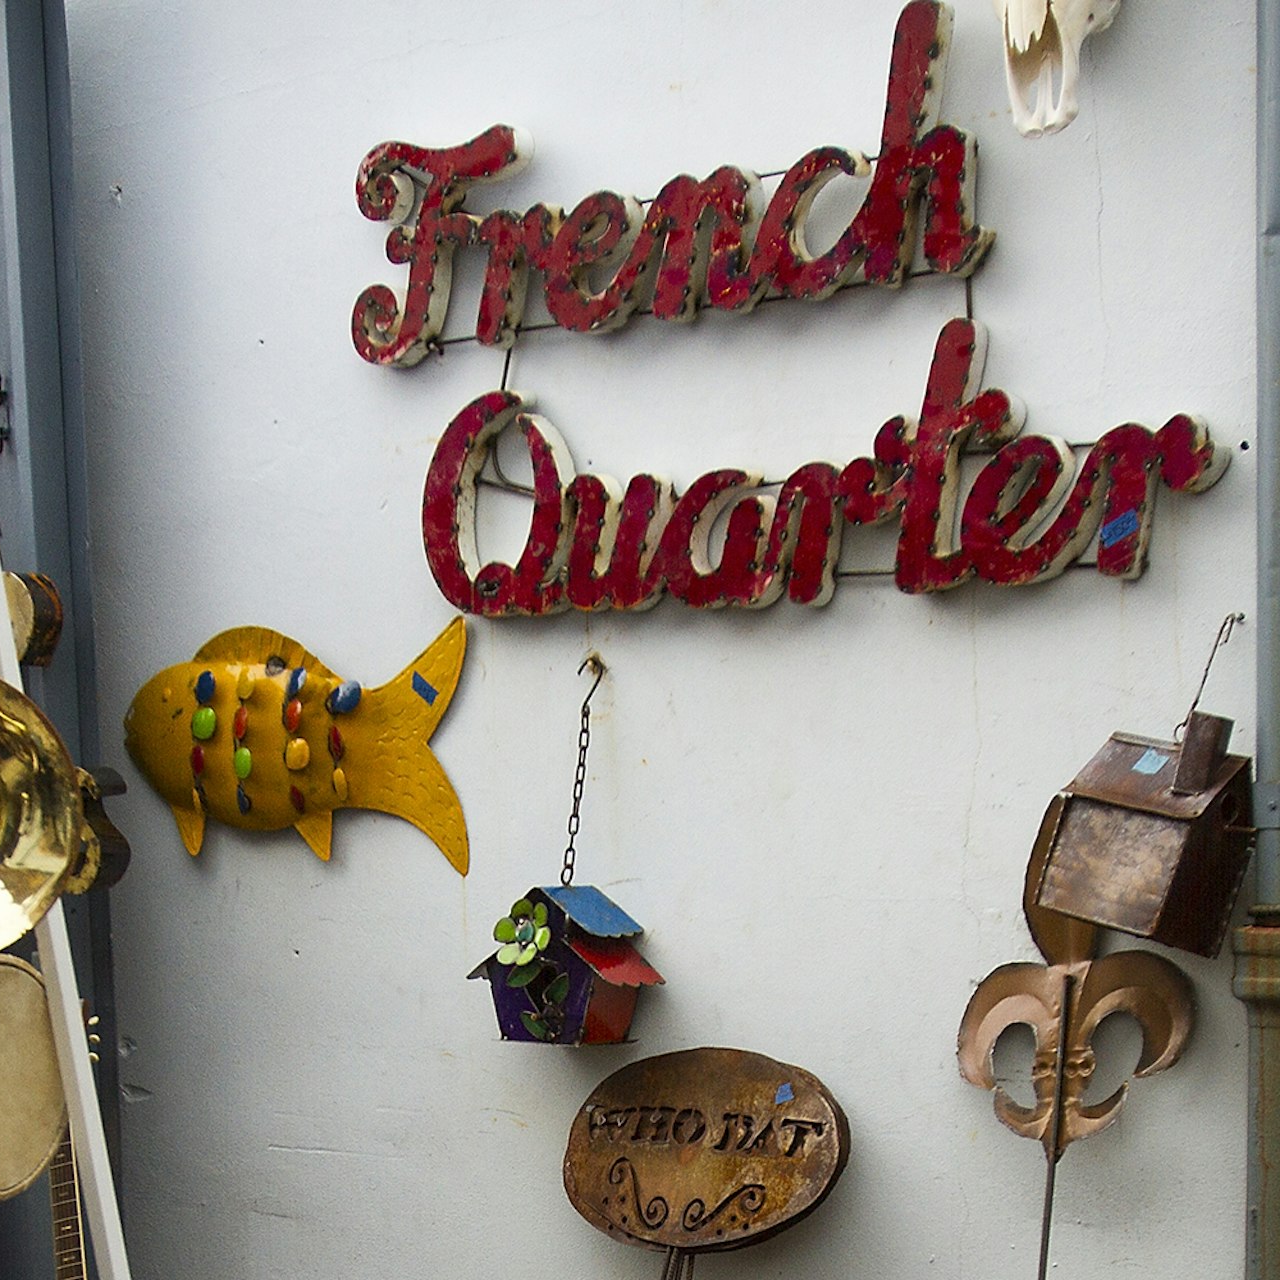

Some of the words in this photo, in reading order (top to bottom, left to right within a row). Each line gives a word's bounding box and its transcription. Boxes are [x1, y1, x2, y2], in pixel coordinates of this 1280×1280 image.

[352, 0, 996, 368] French
[422, 318, 1230, 618] Quarter
[589, 1105, 707, 1146] WHO
[714, 1111, 828, 1158] DAT
